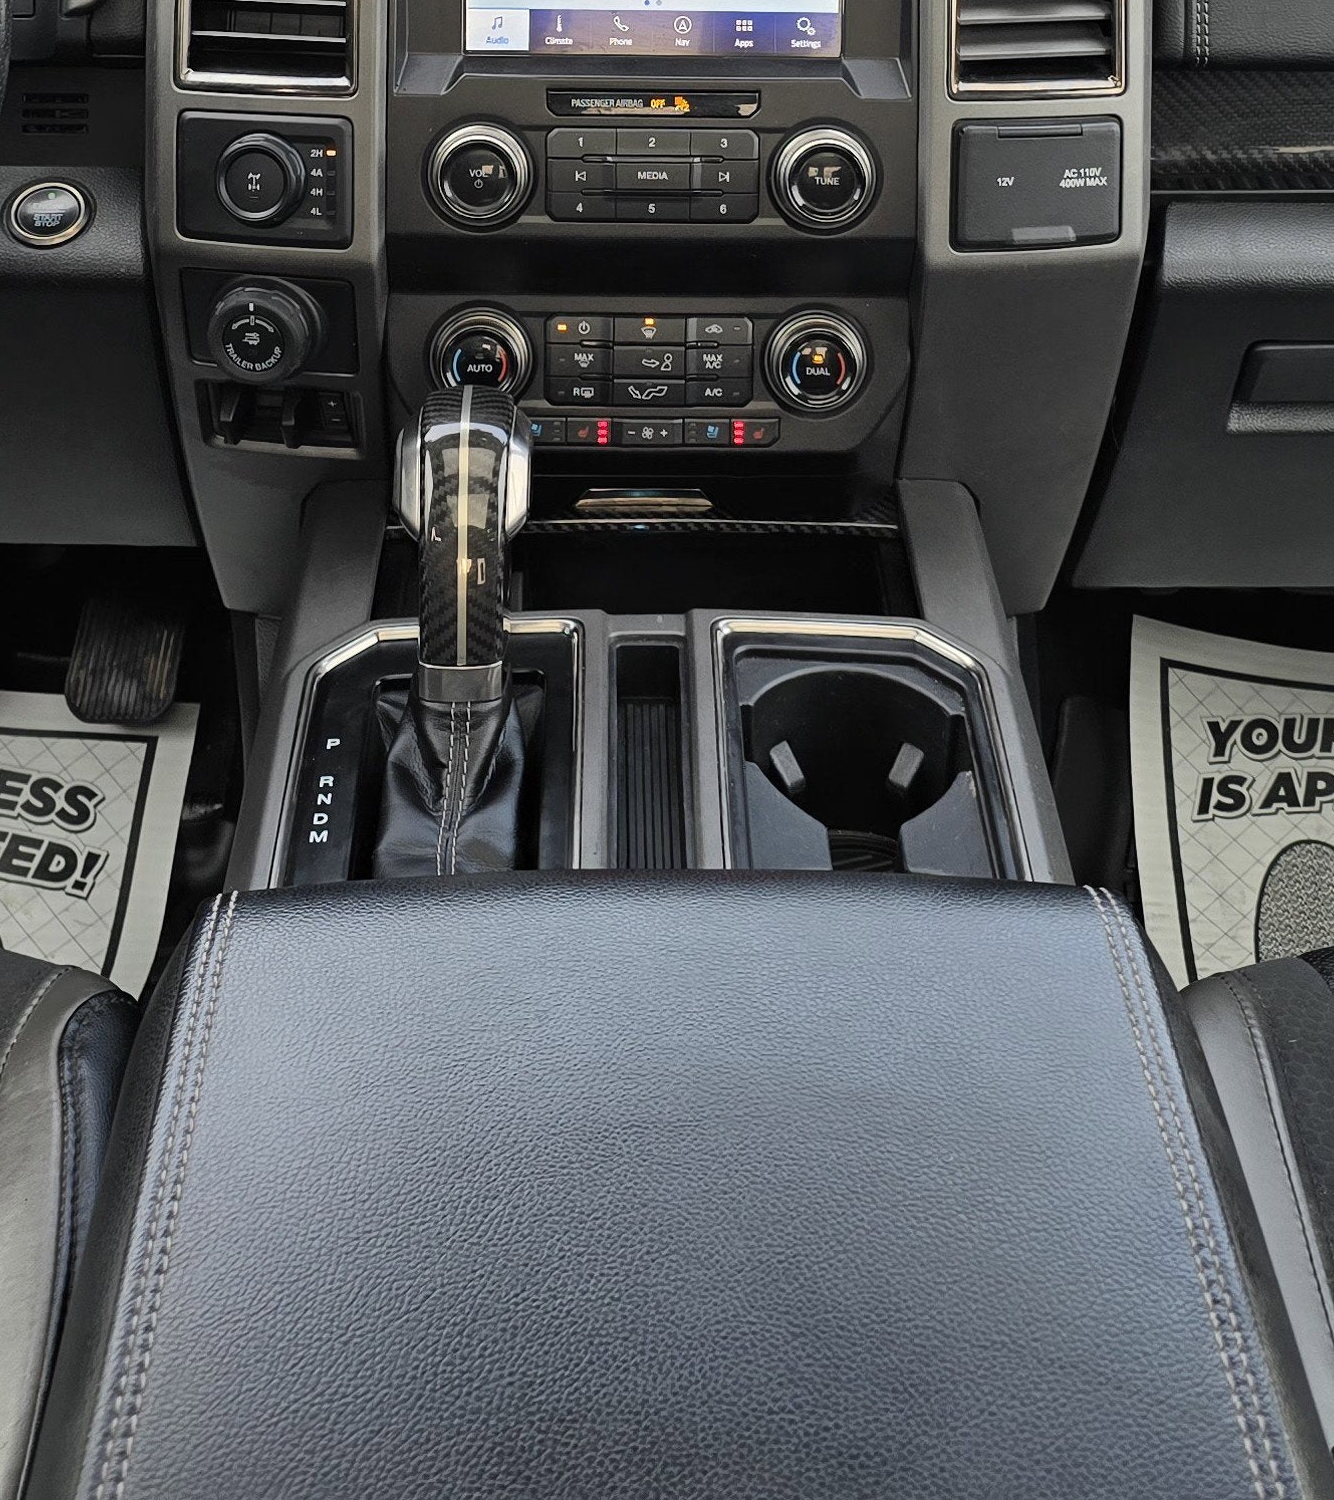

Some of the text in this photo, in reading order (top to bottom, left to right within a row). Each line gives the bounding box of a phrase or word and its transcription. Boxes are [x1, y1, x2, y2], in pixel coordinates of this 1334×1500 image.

[485, 36, 509, 45] Audio
[609, 37, 633, 46] Phone
[675, 38, 690, 47] Nav
[734, 39, 754, 48] Apps
[791, 39, 821, 49] Settings
[571, 99, 614, 108] PASSENGER
[615, 99, 643, 108] AIRBAG
[650, 99, 665, 108] OFF
[578, 137, 584, 147] 1
[648, 137, 655, 147] 2
[720, 138, 728, 148] 3
[310, 149, 323, 158] 2H
[310, 169, 323, 177] 4A
[469, 169, 487, 178] VOL
[637, 171, 668, 181] MEDIA
[1063, 167, 1102, 178] AC 110V
[814, 176, 840, 186] TUNE
[996, 176, 1015, 187] 12V
[1059, 177, 1108, 188] 400W MAX
[310, 188, 323, 197] 4H
[310, 207, 322, 216] 4L
[576, 203, 583, 213] 4
[648, 204, 656, 214] 5
[720, 204, 727, 214] 6
[33, 213, 63, 221] START
[225, 343, 282, 371] TRAILER BACKUP
[574, 353, 595, 362] MAX
[703, 354, 723, 362] MAX
[467, 363, 493, 373] AUTO
[705, 360, 722, 369] A/C
[806, 367, 831, 376] DUAL
[705, 388, 723, 397] A/C
[309, 738, 340, 843] P R N D M
[1194, 772, 1253, 821] IS
